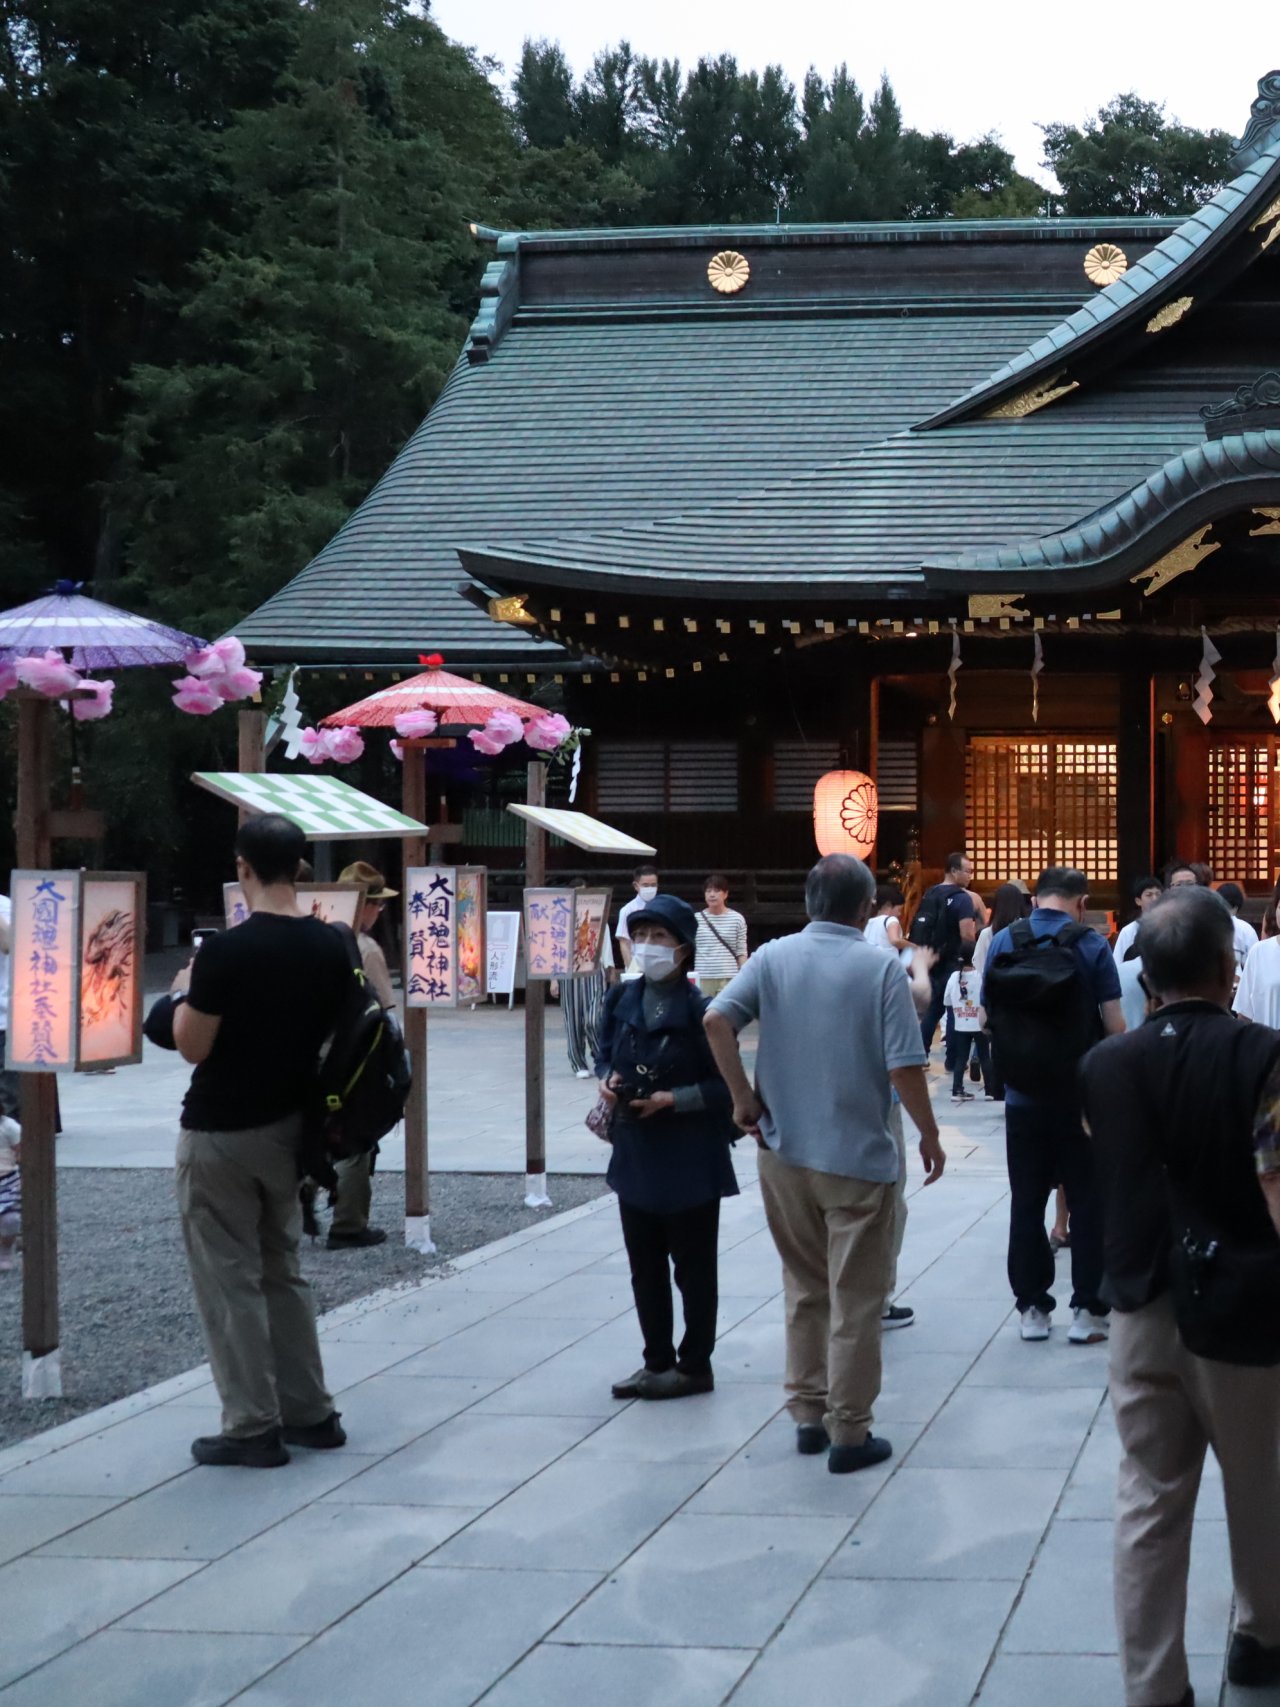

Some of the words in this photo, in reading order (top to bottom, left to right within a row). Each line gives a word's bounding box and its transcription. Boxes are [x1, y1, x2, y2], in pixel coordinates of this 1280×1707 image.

[408, 889, 430, 996] 奉賛会
[426, 873, 454, 1001] 大國魂神社
